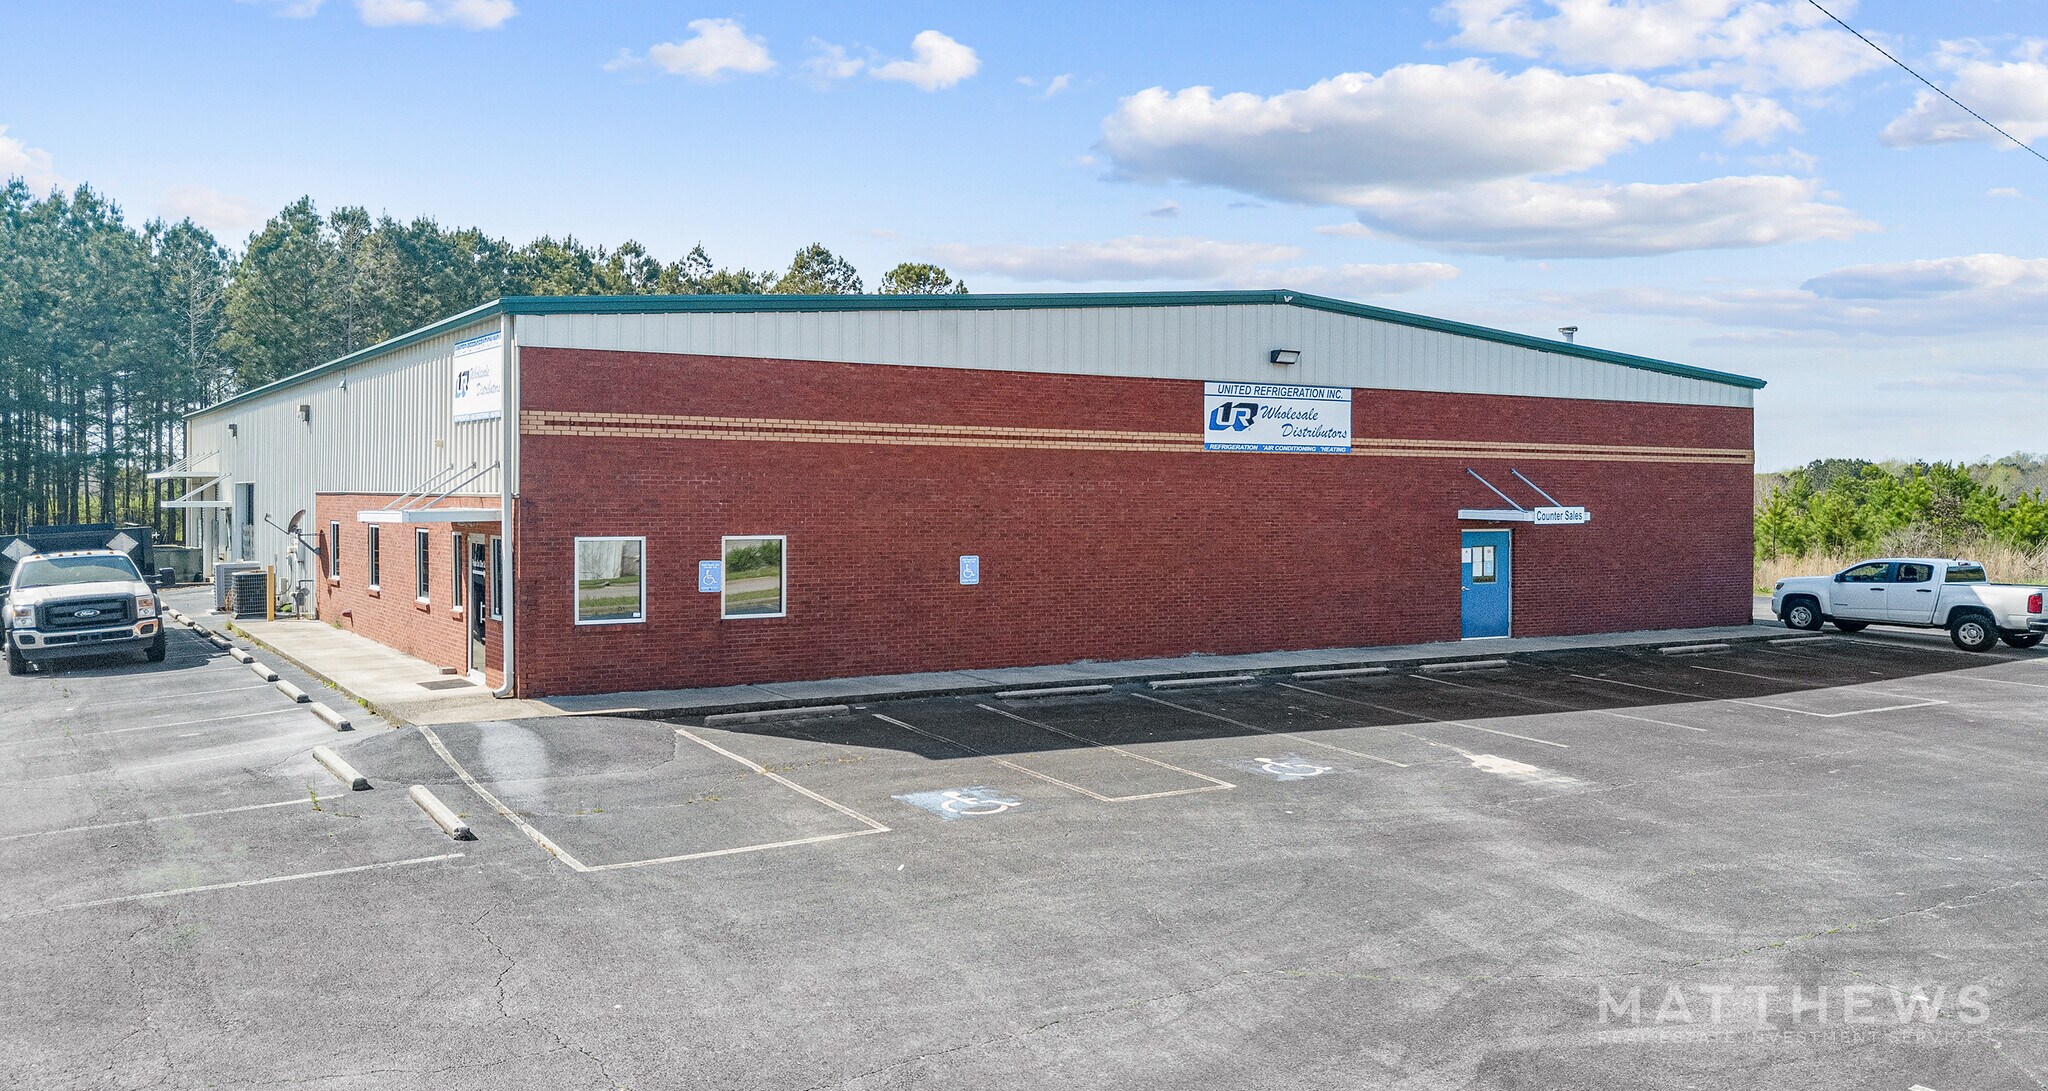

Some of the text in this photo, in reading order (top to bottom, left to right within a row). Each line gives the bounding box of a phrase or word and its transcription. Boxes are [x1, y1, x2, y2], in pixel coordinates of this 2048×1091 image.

[1217, 384, 1343, 399] UNITED REFRIGERATION INC.
[1260, 405, 1319, 421] Wholesale
[1281, 423, 1347, 439] Distributors
[1536, 510, 1583, 521] Counter Sales
